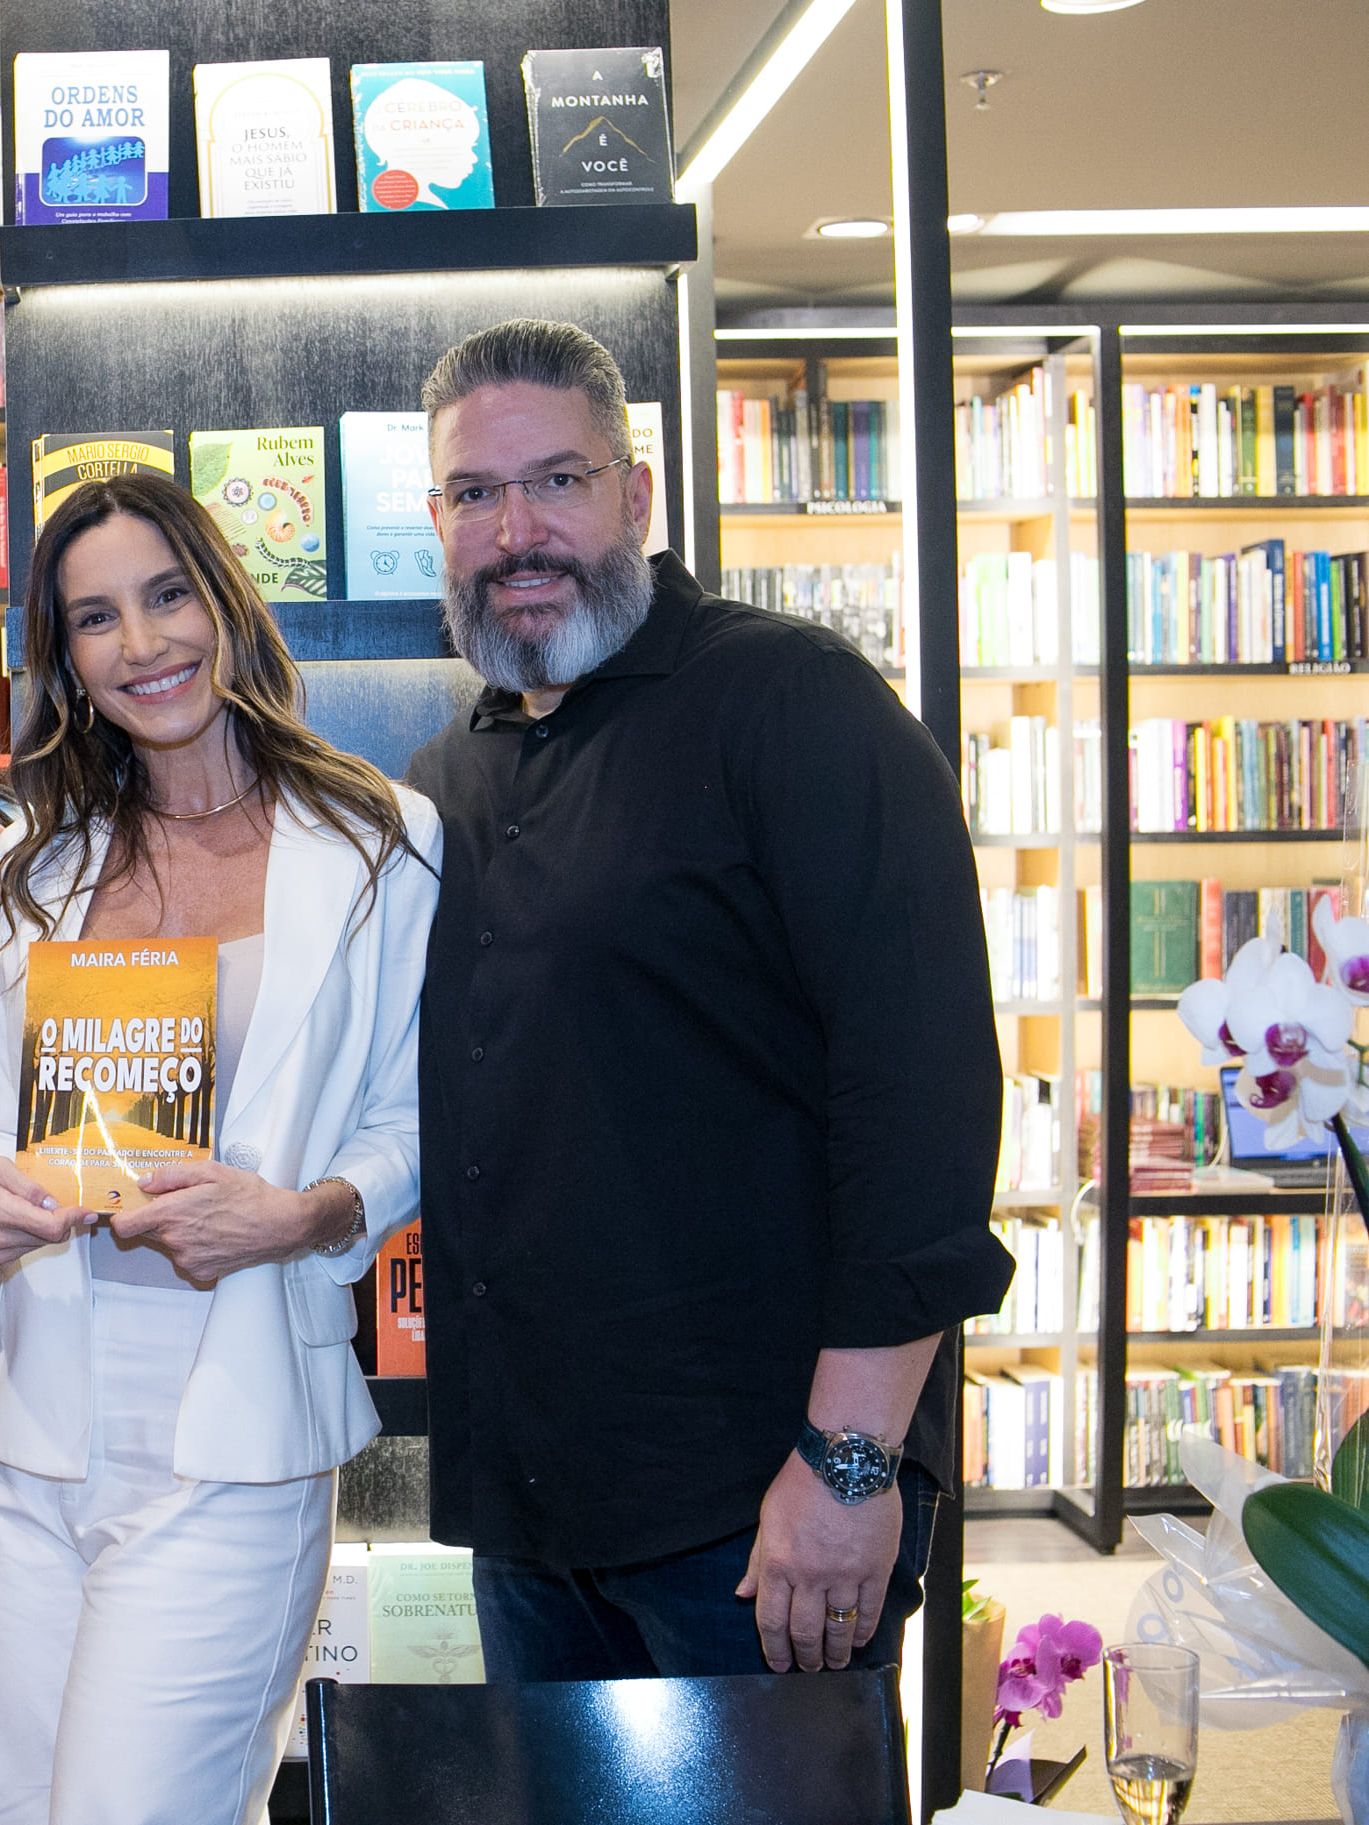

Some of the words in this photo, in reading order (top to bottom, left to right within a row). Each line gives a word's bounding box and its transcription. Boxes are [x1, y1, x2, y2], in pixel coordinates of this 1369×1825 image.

[591, 70, 603, 80] A
[51, 85, 138, 105] ORDENS
[551, 94, 649, 108] MONTANHA
[44, 109, 73, 128] DO
[81, 108, 145, 127] AMOR
[390, 118, 465, 133] CRIANÇA
[243, 126, 291, 143] JESUS,
[598, 133, 608, 146] É
[231, 143, 243, 153] O
[247, 140, 303, 152] HOMEM
[230, 154, 263, 167] MAIS
[581, 157, 629, 172] VOCÊ
[244, 166, 277, 180] QUE
[244, 179, 295, 191] EXISTIU
[387, 424, 399, 432] Dr.
[401, 424, 424, 432] Mark
[257, 435, 314, 451] Rubem
[273, 452, 315, 467] Alves
[806, 501, 888, 515] PSICOLOGIA
[70, 952, 126, 968] MAIRA
[131, 948, 179, 966] FÉRIA
[41, 1017, 58, 1047] O
[62, 1017, 176, 1054] MILAGRE
[180, 1016, 203, 1045] DO
[38, 1055, 203, 1104] RECOMEÇO
[39, 1147, 82, 1156] LIBERTE-S
[406, 1232, 422, 1256] ES
[332, 1575, 358, 1585] M.D.
[396, 1593, 431, 1602] COMO
[433, 1592, 448, 1602] SE
[449, 1592, 476, 1601] TORN
[382, 1603, 477, 1617] SOBRENATU
[305, 1645, 358, 1662] INO
